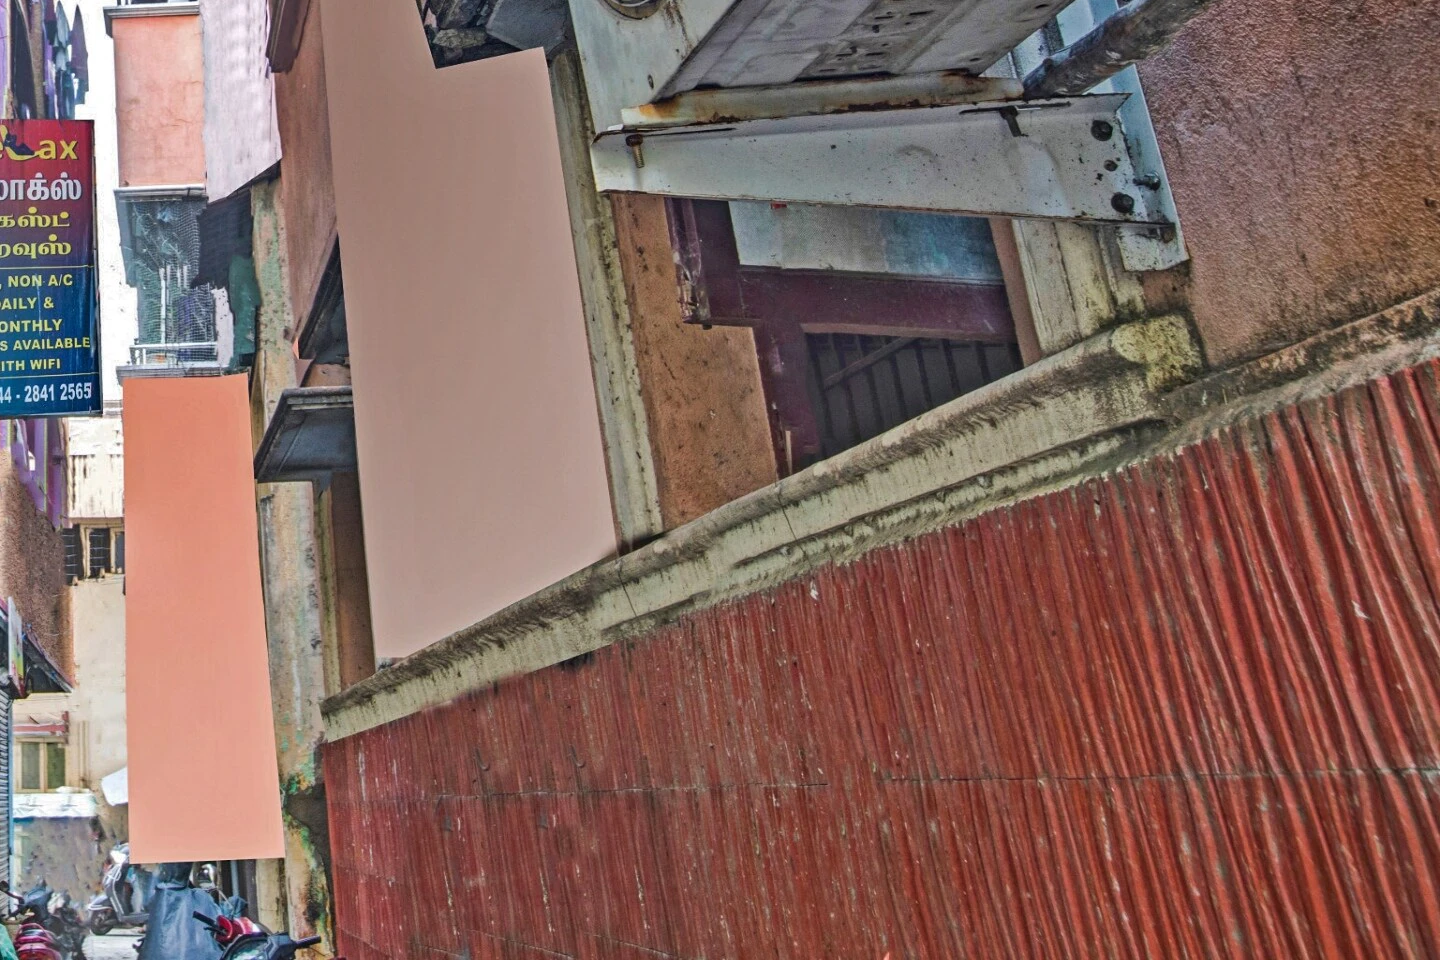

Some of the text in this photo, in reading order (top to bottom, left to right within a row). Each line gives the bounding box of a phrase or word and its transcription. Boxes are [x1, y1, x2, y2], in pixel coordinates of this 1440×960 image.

[48, 274, 73, 286] A/C
[43, 296, 55, 309] &
[13, 337, 91, 351] AVAILABLE
[30, 358, 61, 370] WIFI
[24, 384, 55, 403] 2841
